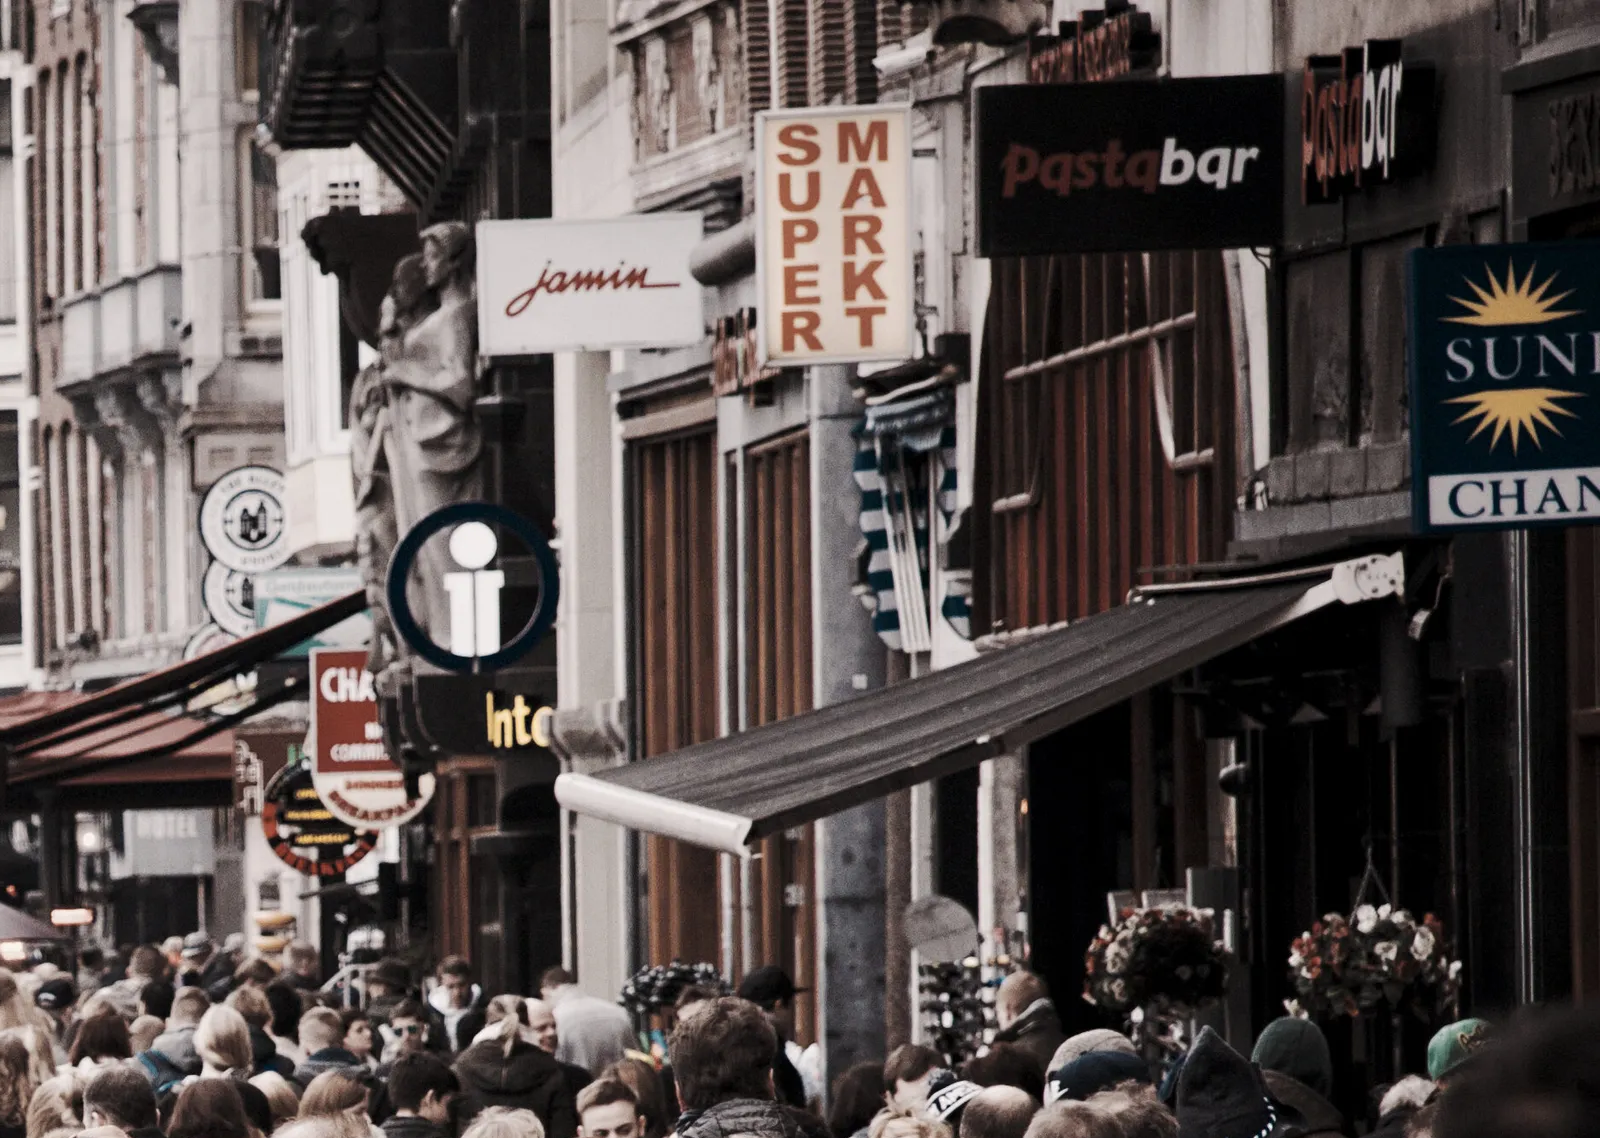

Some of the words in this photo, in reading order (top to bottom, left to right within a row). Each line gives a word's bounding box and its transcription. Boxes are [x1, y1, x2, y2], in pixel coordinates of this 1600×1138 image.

[1000, 137, 1260, 198] pastabar
[1301, 42, 1403, 205] pastabar
[505, 260, 681, 317] jamin
[776, 123, 825, 353] SUPER
[837, 120, 889, 348] MARKT
